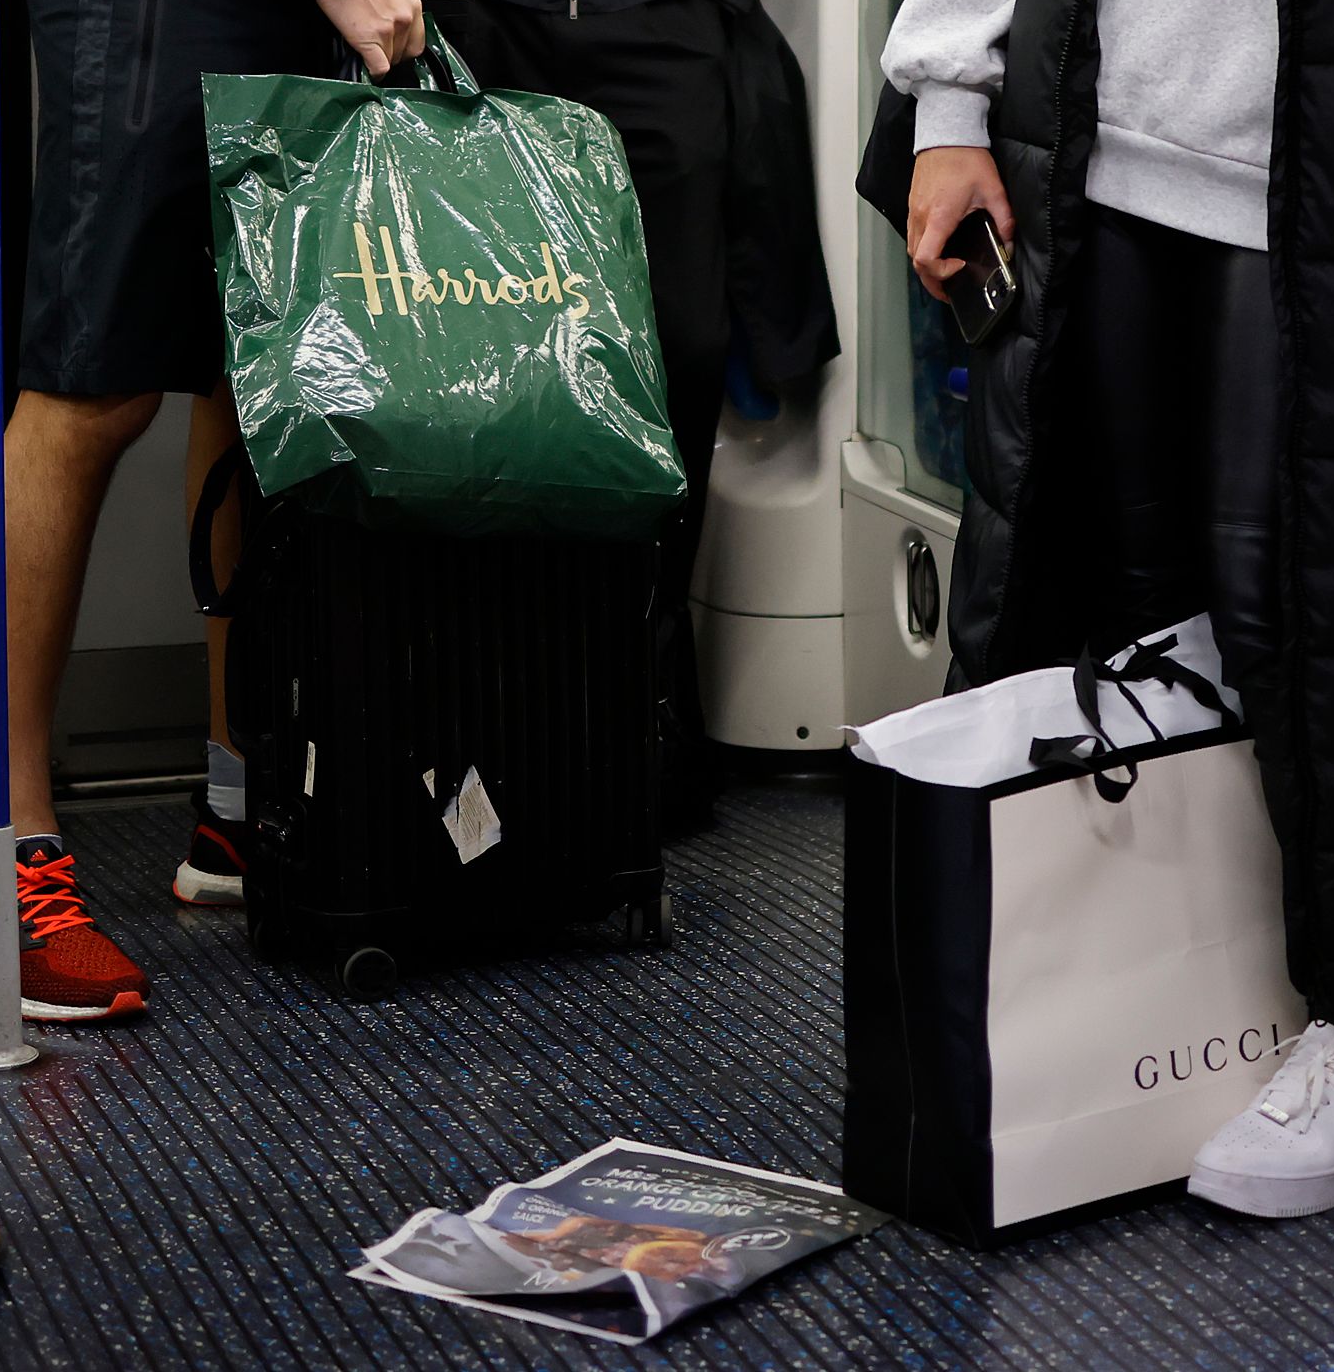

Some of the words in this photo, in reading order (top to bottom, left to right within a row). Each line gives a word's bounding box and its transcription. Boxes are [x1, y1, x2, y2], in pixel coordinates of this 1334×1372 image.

[333, 222, 590, 320] Harrods
[1135, 1024, 1280, 1090] GUCCI
[580, 1177, 683, 1195] ORANGE
[632, 1195, 755, 1217] PUDDING
